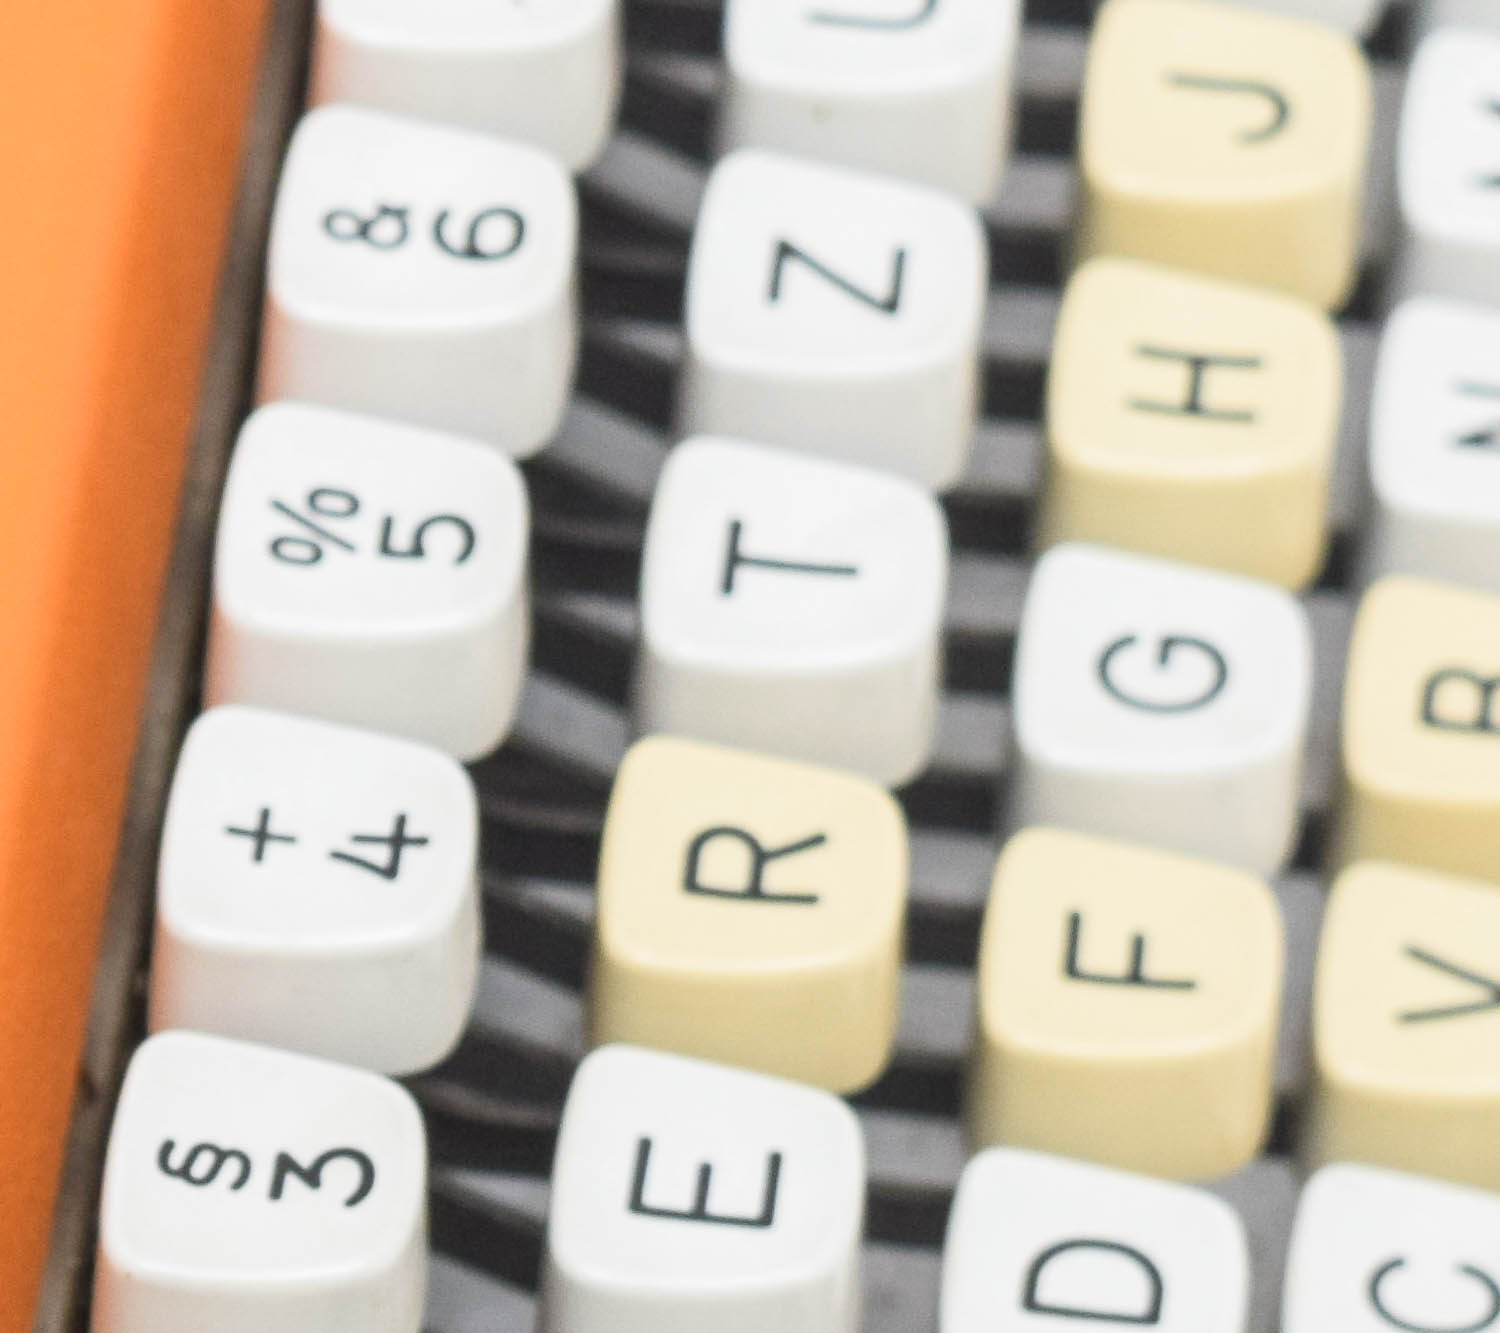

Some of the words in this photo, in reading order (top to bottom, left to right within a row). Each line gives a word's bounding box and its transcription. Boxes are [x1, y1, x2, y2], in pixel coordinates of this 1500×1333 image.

[1168, 72, 1294, 146] J
[320, 203, 410, 249] &
[431, 206, 527, 263] 6
[766, 238, 907, 317] Z
[1132, 345, 1262, 424] H
[267, 486, 362, 568] %
[377, 513, 478, 566] 5
[718, 518, 858, 597] T
[1094, 633, 1230, 715] G
[225, 806, 297, 864] +
[329, 812, 431, 882] 4
[680, 824, 828, 907] R
[1061, 910, 1197, 992] F
[156, 1138, 253, 1192] §
[267, 1146, 377, 1209] 3
[626, 1136, 784, 1231] E
[1019, 1237, 1165, 1327] D
